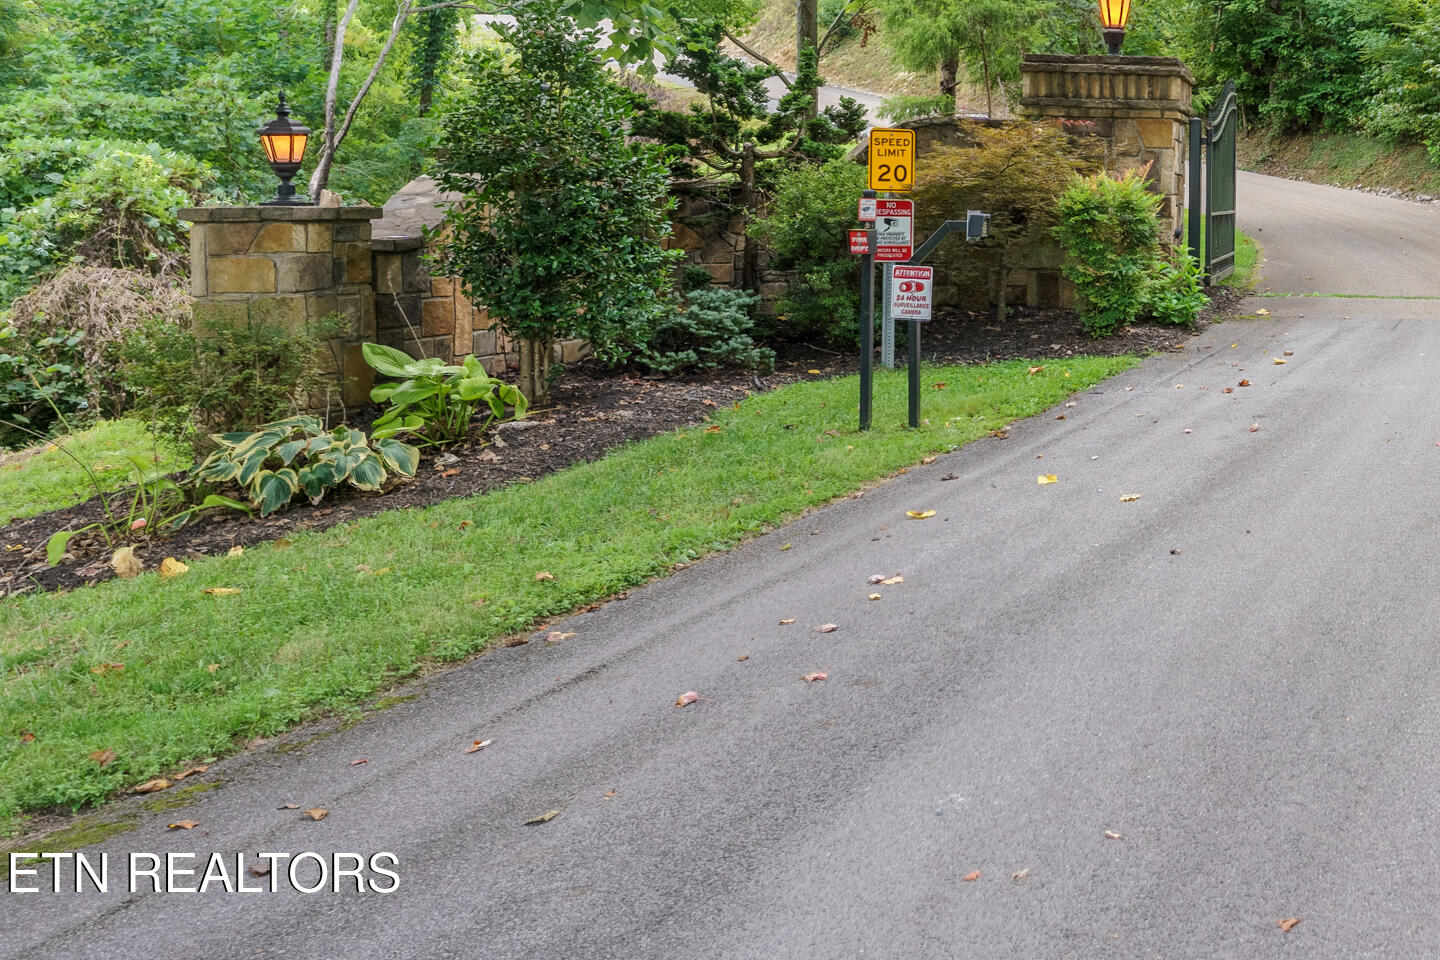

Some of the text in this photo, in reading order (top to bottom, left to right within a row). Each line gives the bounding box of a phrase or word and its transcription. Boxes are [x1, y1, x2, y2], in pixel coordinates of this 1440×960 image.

[874, 138, 910, 146] SPEED
[877, 148, 906, 157] LIMIT
[878, 164, 907, 182] 20
[877, 208, 912, 216] ESPASSING
[895, 269, 930, 278] ATTENTION
